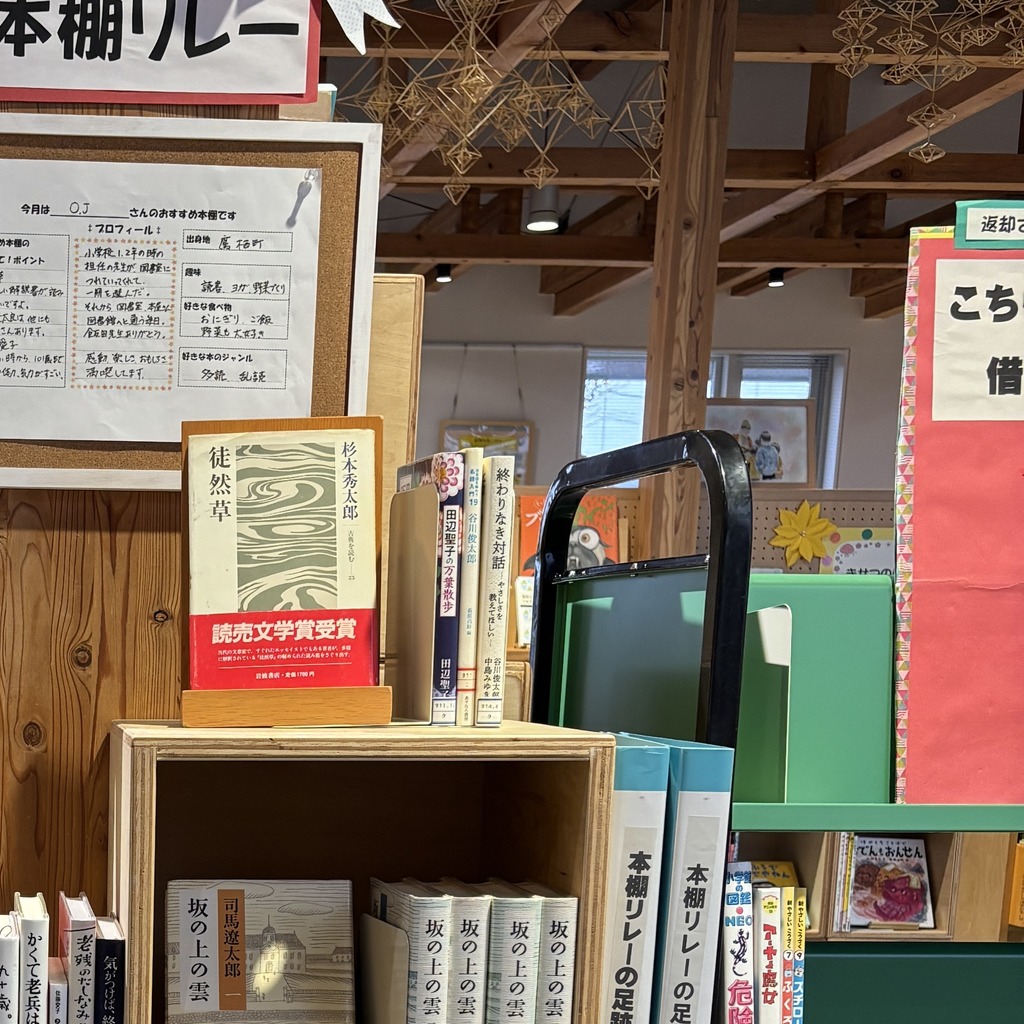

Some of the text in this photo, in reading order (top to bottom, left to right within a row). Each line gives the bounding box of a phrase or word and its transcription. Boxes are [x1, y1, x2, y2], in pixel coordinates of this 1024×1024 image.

[95, 224, 154, 235] プロフィール
[129, 208, 237, 220] さんのおすすめ本棚です
[186, 235, 211, 244] 出身地
[184, 302, 232, 312] 好きな食べ物
[950, 284, 1024, 323] こち
[182, 352, 254, 363] 好きな本のジャンル
[987, 357, 1024, 396] 借
[208, 446, 232, 523] 徒然草
[341, 441, 359, 521] 杉本秀太郎
[467, 513, 478, 564] 谷川俊太郎
[492, 467, 510, 570] 終わりなき対話
[442, 508, 457, 614] 田辺聖子の万葉散歩
[487, 593, 497, 639] 教えてほしい
[496, 582, 505, 621] やさしさを
[211, 618, 357, 645] 読売文学賞受賞
[726, 870, 752, 885] 小学館
[726, 893, 751, 905] 図鑑
[223, 897, 241, 978] 司馬遼太郎
[725, 916, 753, 927] NEO
[187, 897, 210, 1002] 坂の上の雲
[423, 918, 445, 1016] 坂の上の雲
[457, 918, 480, 1015] 坂の上の雲
[506, 920, 530, 1018] 坂の上の雲
[544, 919, 569, 1018] 坂の上の雲
[762, 923, 779, 1005] アーヤと魔女
[73, 934, 92, 1021] 老残のたしなみ
